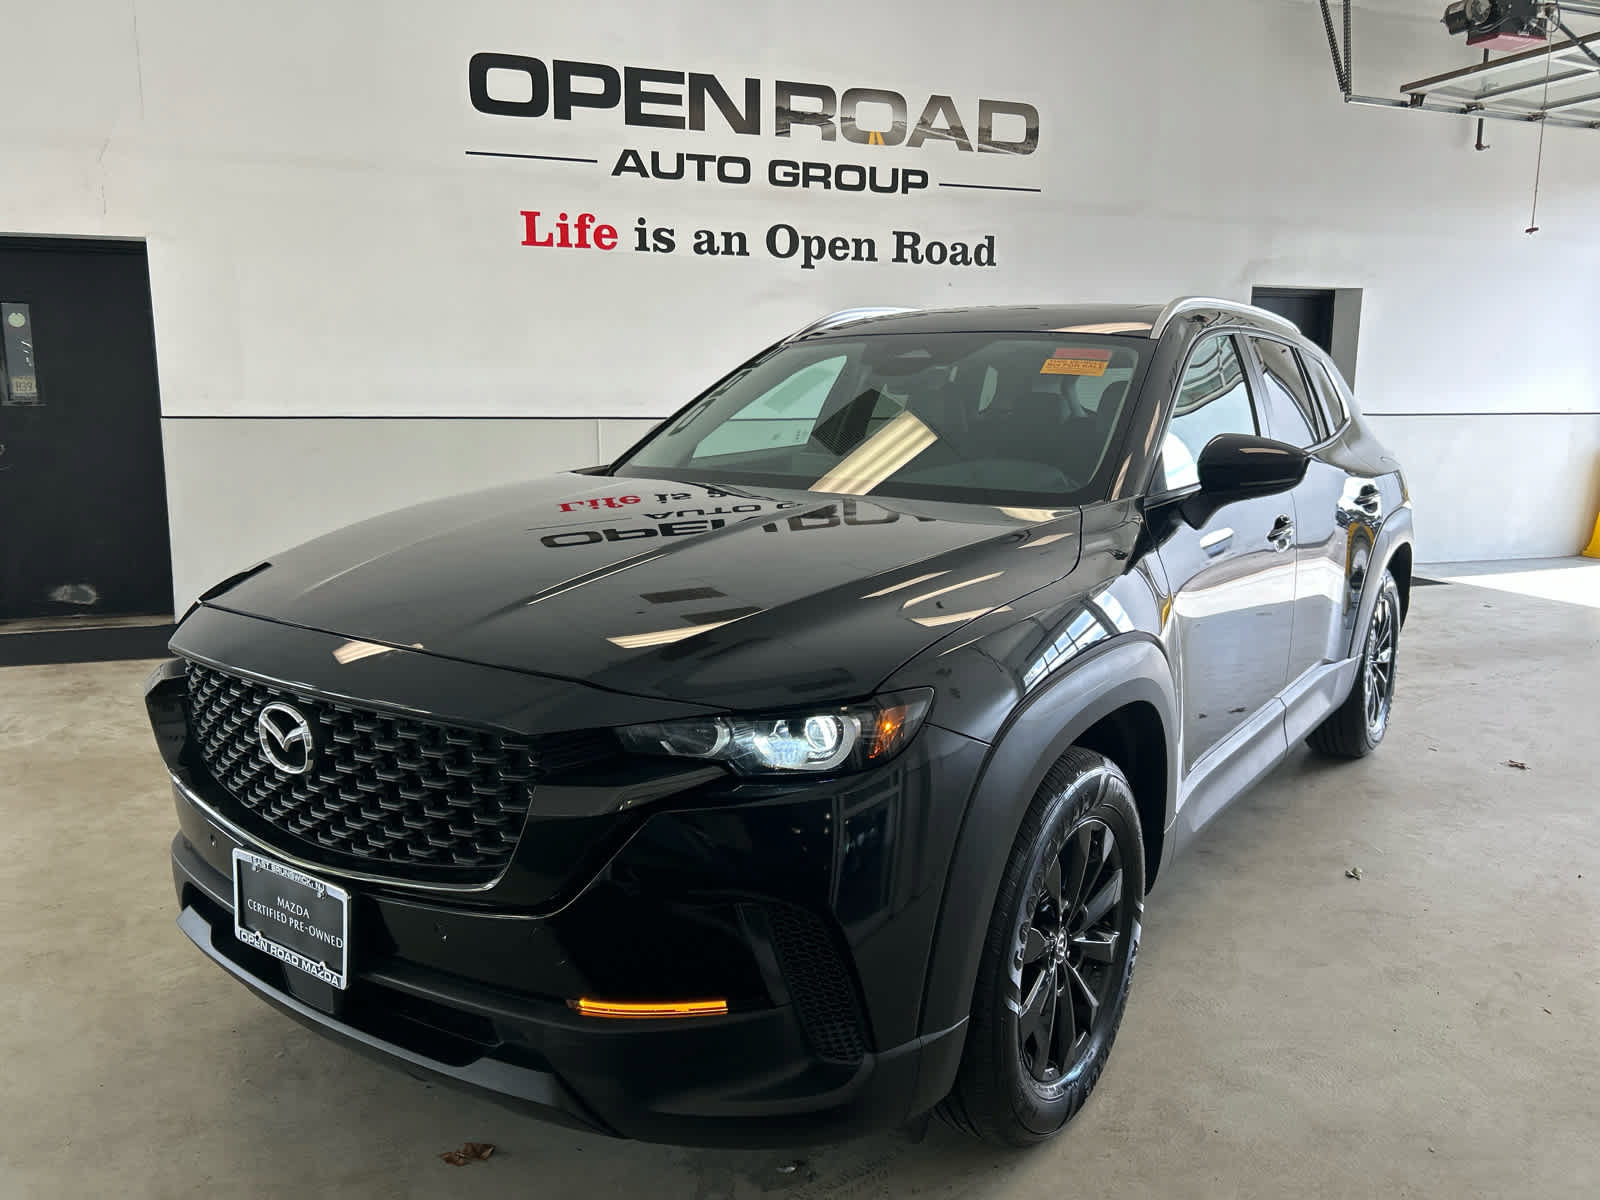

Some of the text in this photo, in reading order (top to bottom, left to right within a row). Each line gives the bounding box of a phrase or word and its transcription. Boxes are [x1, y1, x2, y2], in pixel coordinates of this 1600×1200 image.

[469, 53, 1040, 156] OPEN ROAD
[610, 149, 929, 195] AUTO GROUP
[520, 210, 997, 269] Life is an Open Road
[247, 899, 343, 949] CERTIFIED PRE-OWNED
[277, 896, 310, 919] MAZDA
[241, 932, 340, 987] OPEN ROAD MAZDA
